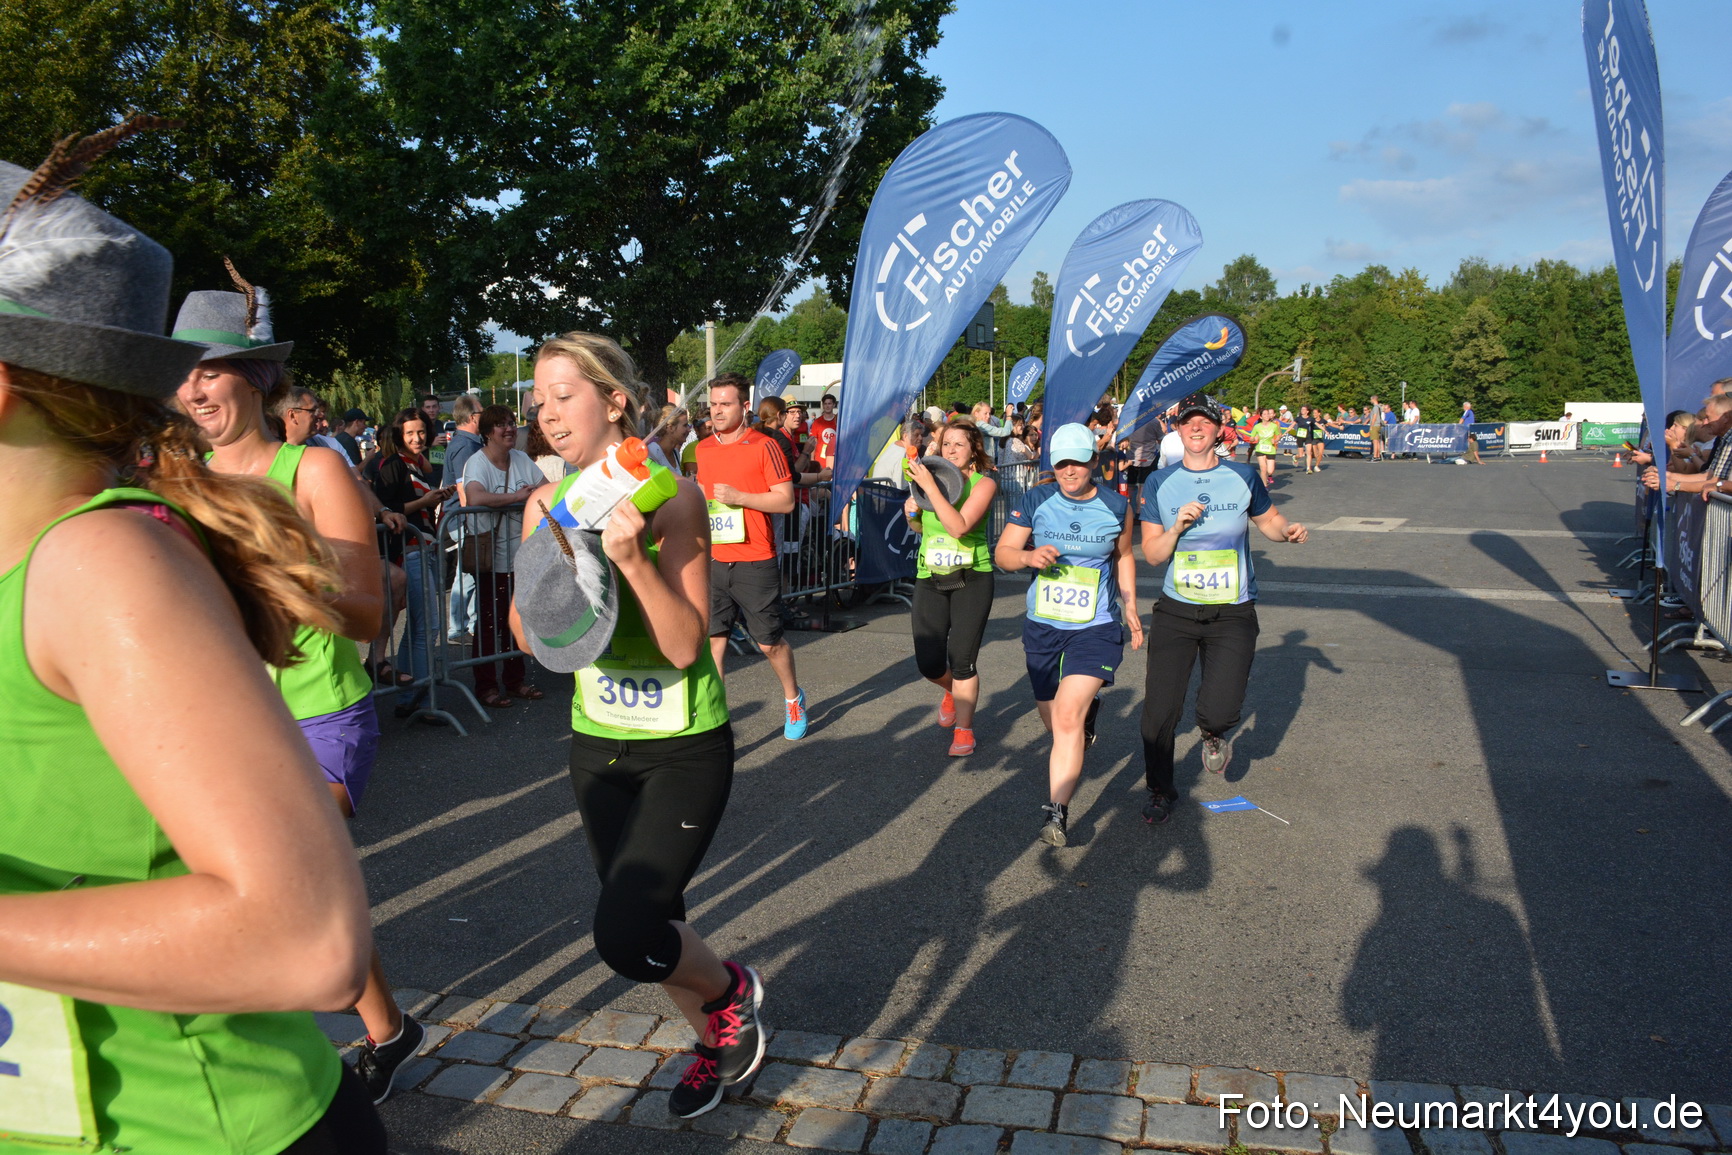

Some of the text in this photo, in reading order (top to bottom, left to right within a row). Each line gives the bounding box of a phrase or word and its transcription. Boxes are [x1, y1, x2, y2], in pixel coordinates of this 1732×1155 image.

[903, 149, 1023, 306] Fischer
[944, 180, 1037, 304] AUTOMOBILE
[1085, 223, 1169, 338] Fischer
[1114, 244, 1178, 336] AUTOMOBILE
[764, 356, 792, 393] Fischer
[1016, 362, 1037, 392] Fischer
[1135, 351, 1213, 403] Frischmann
[1185, 366, 1204, 382] Druck
[1215, 345, 1240, 365] Medien
[1414, 430, 1455, 444] Fischer
[1534, 429, 1561, 441] swn
[1586, 427, 1605, 437] AOK
[1044, 530, 1106, 544] SCHABMÜLLER
[1043, 584, 1090, 608] 1328
[1181, 571, 1230, 590] 1341
[597, 676, 663, 709] 309
[606, 711, 630, 721] Theresa
